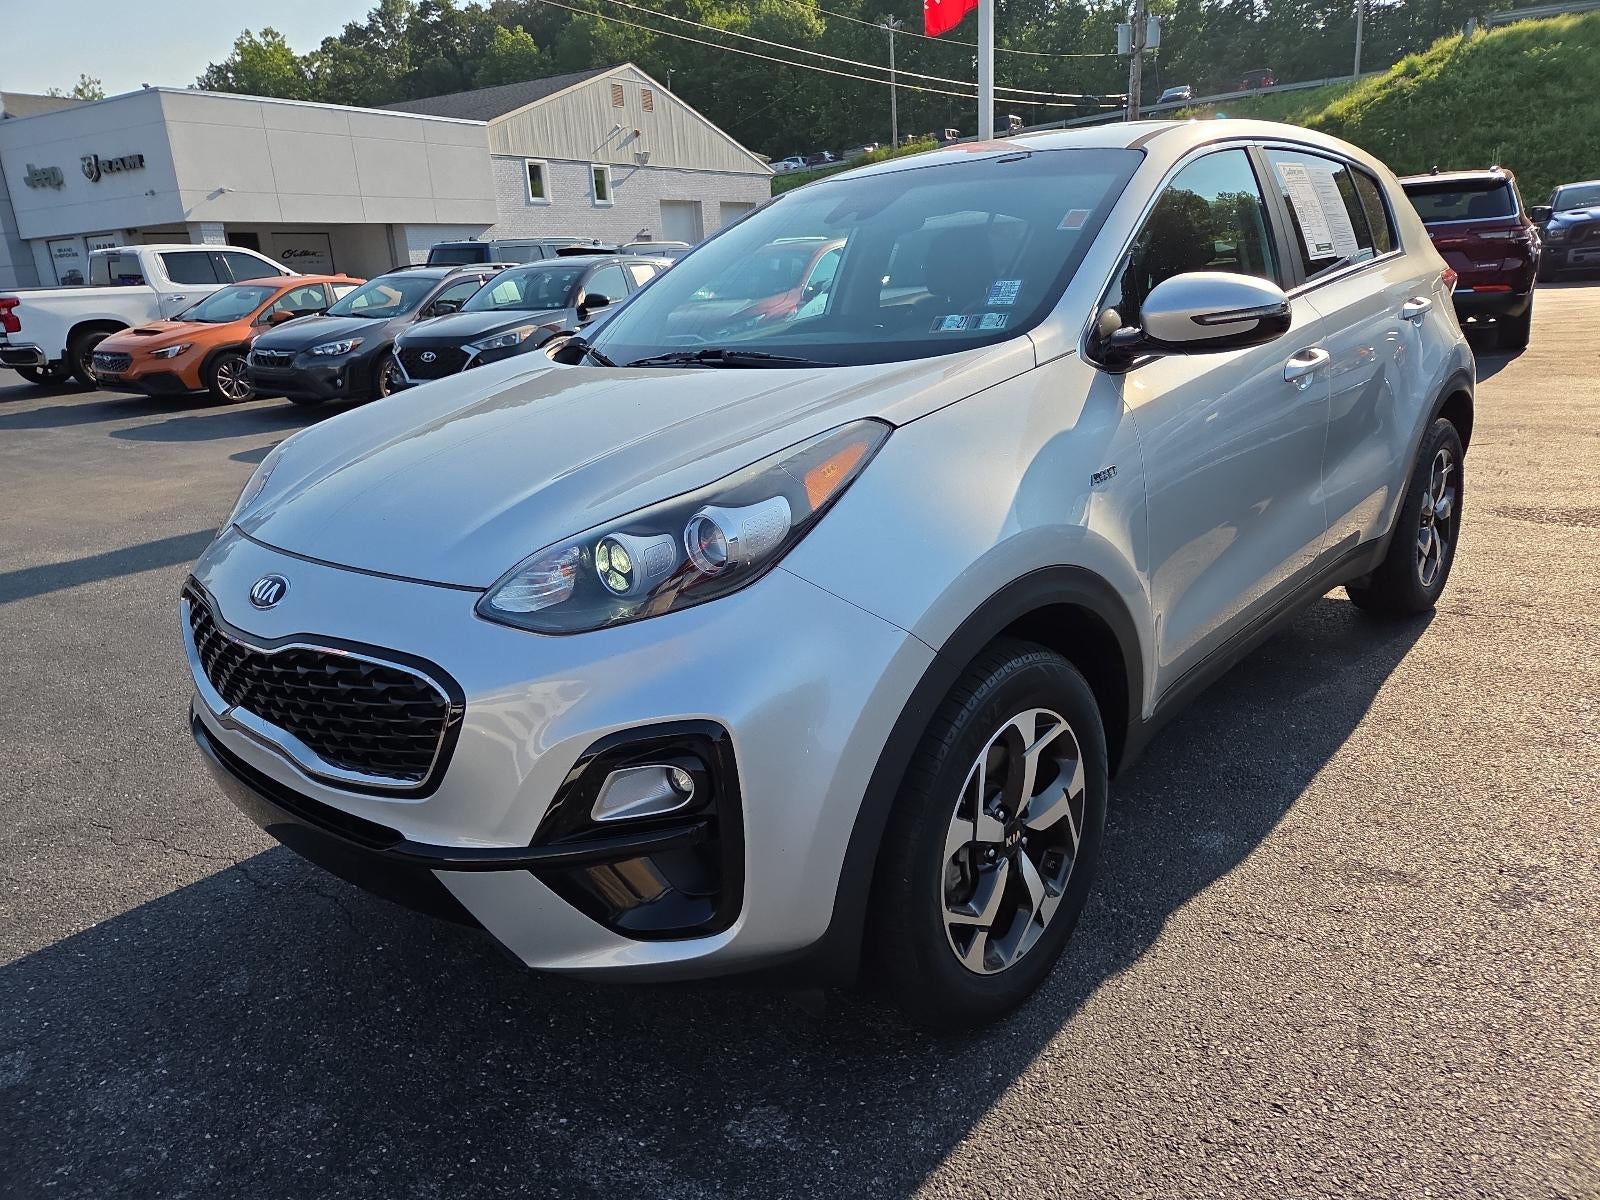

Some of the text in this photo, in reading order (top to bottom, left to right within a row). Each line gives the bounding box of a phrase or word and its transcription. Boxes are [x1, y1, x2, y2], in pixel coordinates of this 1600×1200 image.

[100, 154, 144, 174] RAM
[24, 163, 64, 190] Jeep
[995, 314, 1008, 327] 27
[251, 579, 280, 603] KIA
[1005, 830, 1021, 848] KIA
